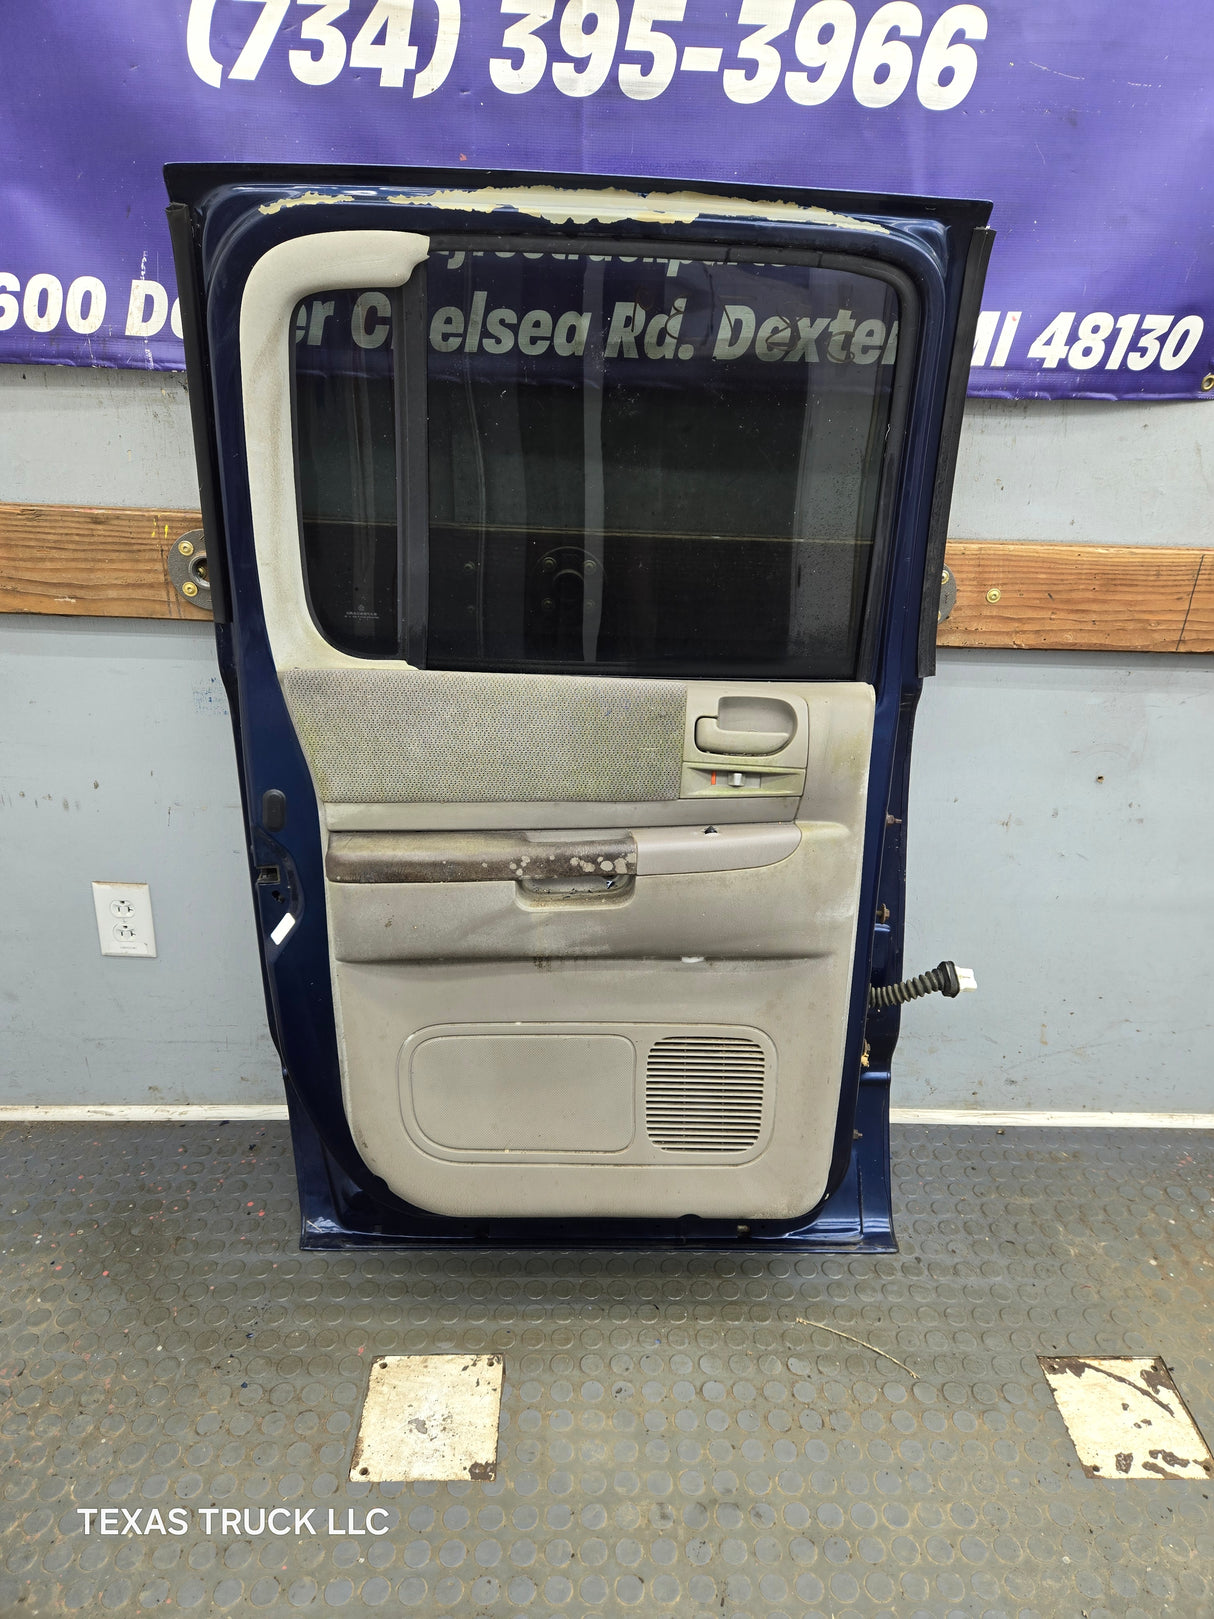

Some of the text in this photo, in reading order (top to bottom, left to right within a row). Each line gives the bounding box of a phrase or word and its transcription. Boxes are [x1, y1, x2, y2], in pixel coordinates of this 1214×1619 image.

[186, 0, 989, 111] (734) 395-3966
[351, 290, 592, 356] Celsea
[603, 297, 696, 360] Rd.
[1027, 311, 1205, 372] 48130
